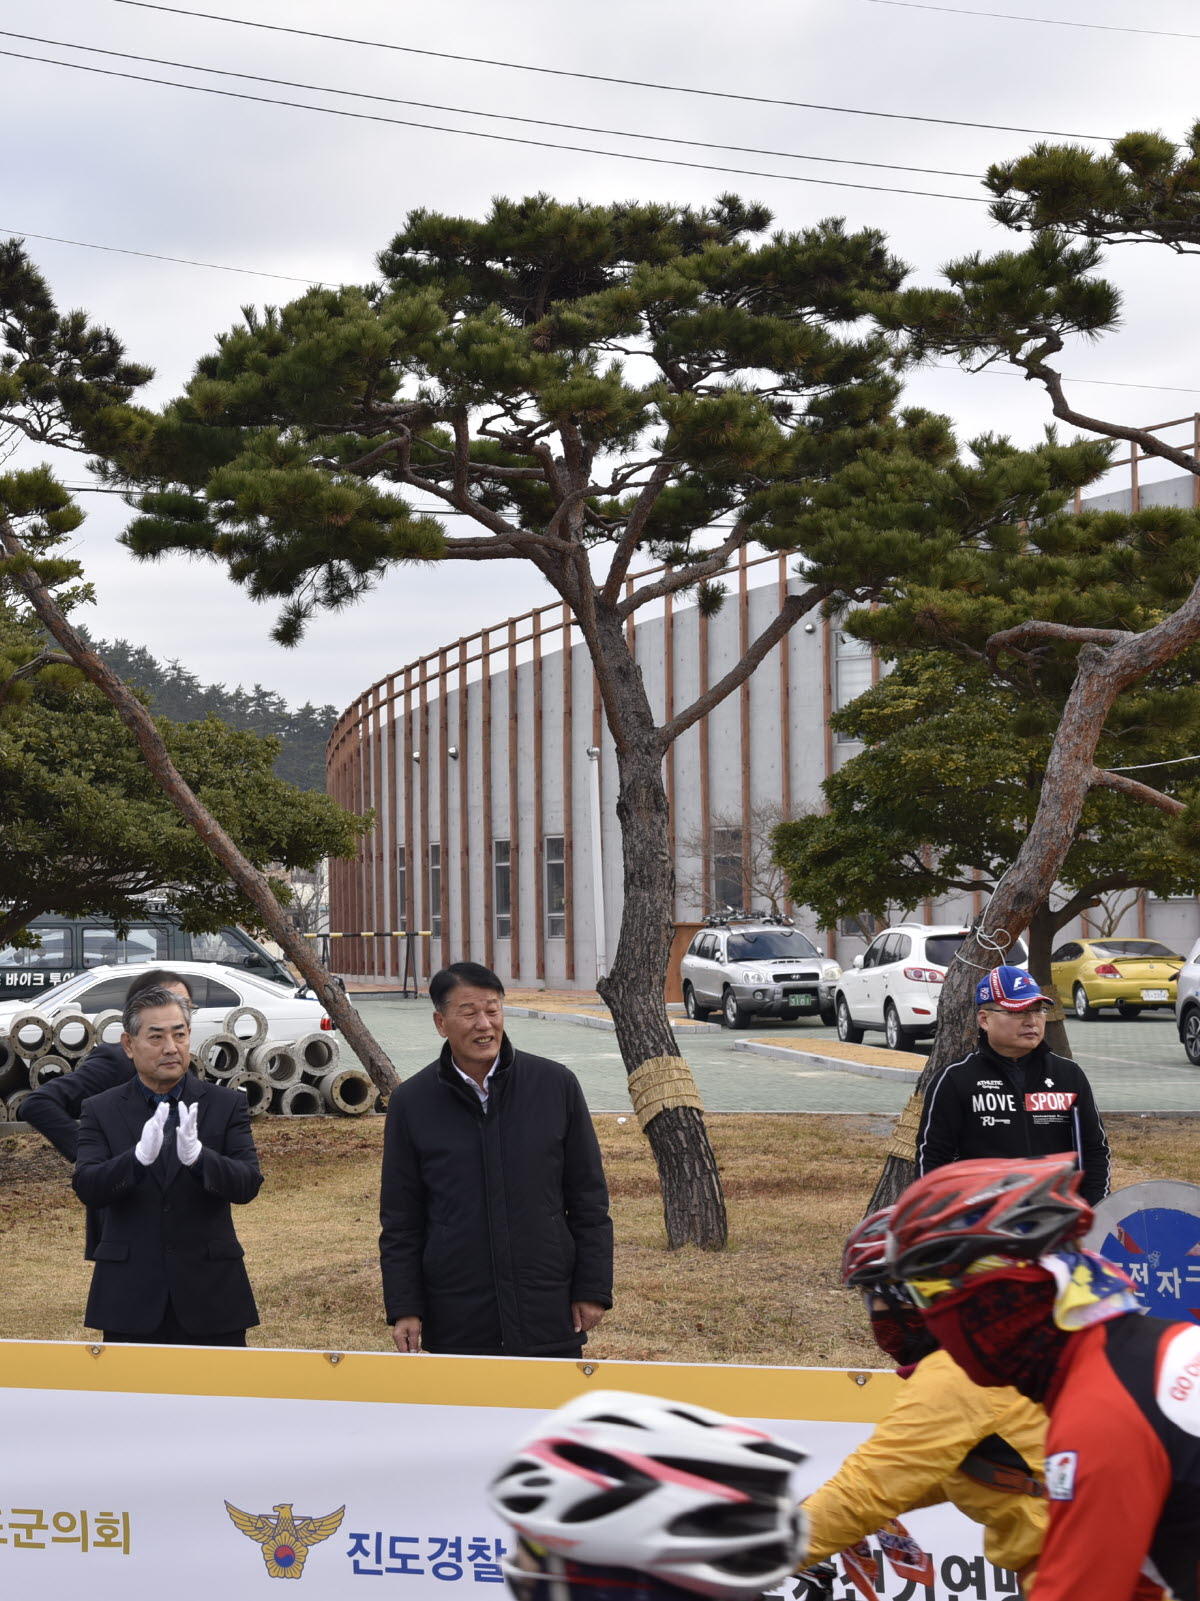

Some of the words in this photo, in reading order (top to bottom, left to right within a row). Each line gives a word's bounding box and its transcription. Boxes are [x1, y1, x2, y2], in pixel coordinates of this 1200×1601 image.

[5, 972, 45, 987] 바이크
[972, 1093, 1017, 1113] MOVE
[1030, 1093, 1074, 1111] SPORT
[346, 1531, 508, 1584] 진도경찰
